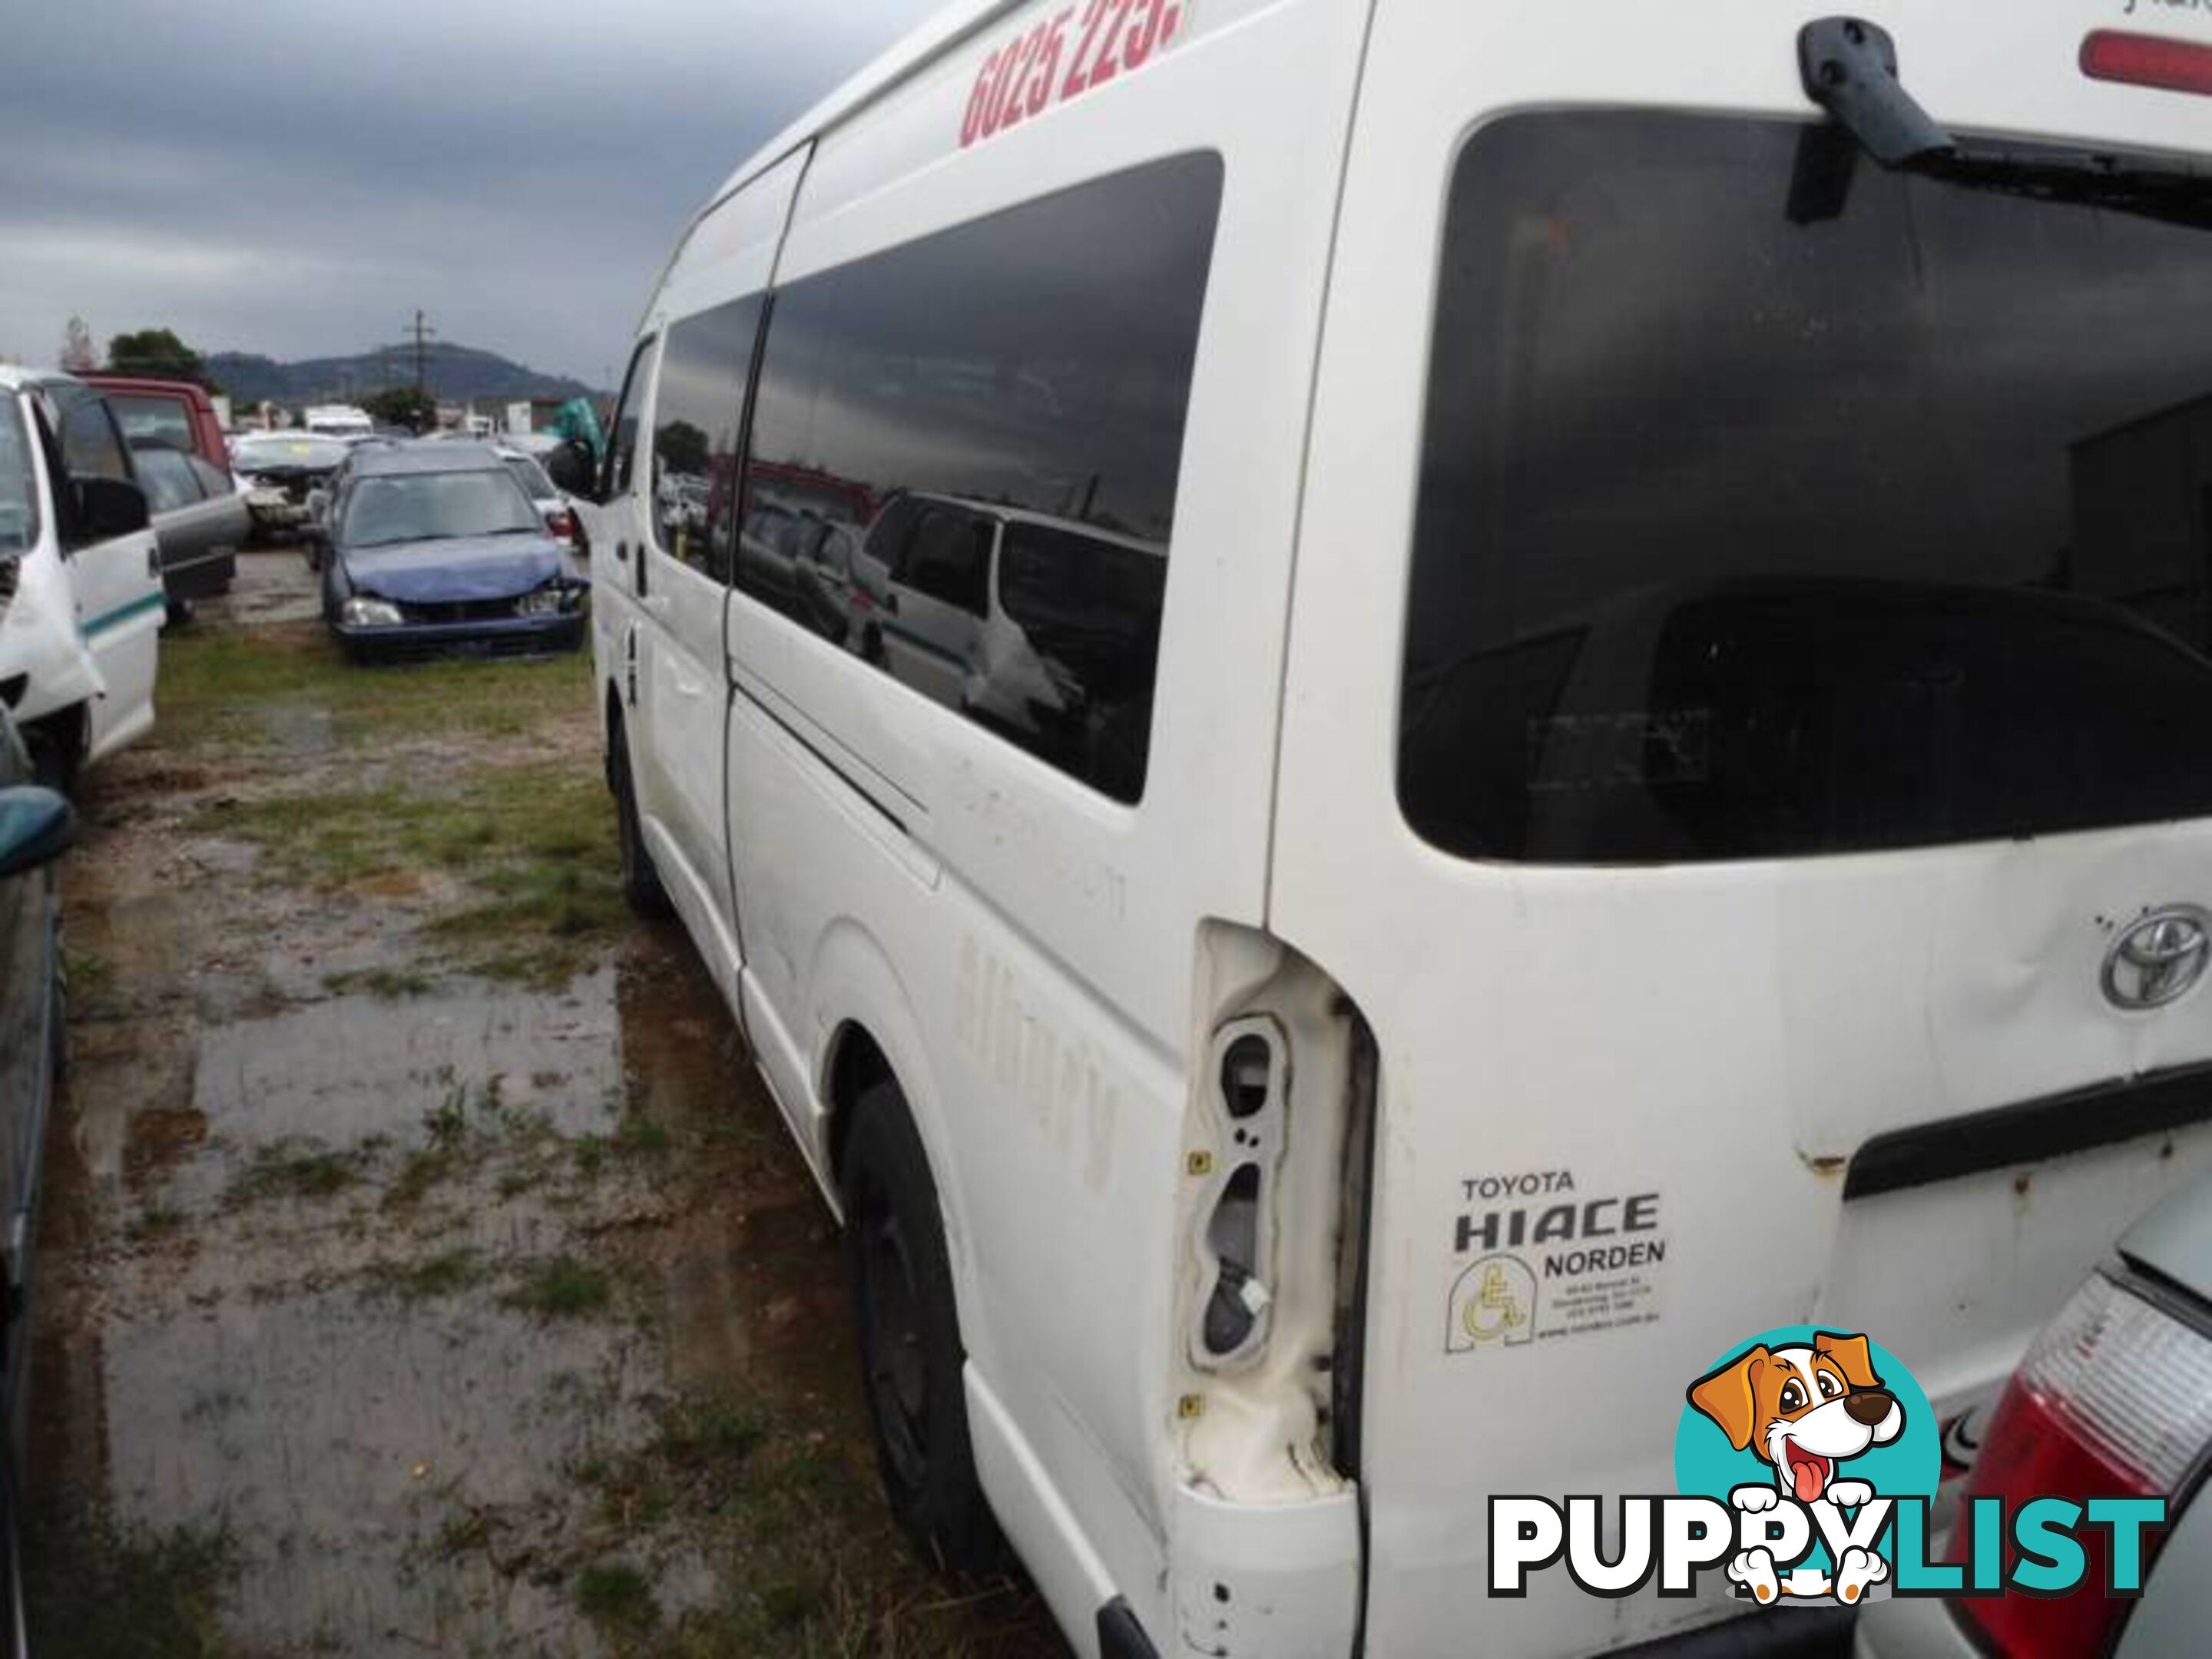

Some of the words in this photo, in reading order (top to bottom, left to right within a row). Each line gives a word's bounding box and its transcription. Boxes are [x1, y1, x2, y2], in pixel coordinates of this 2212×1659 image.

[960, 8, 1075, 147] 6025
[1462, 1171, 1575, 1200] TOYOTA
[1455, 1193, 1661, 1253] HIACE
[1544, 1240, 1667, 1279] NORDEN
